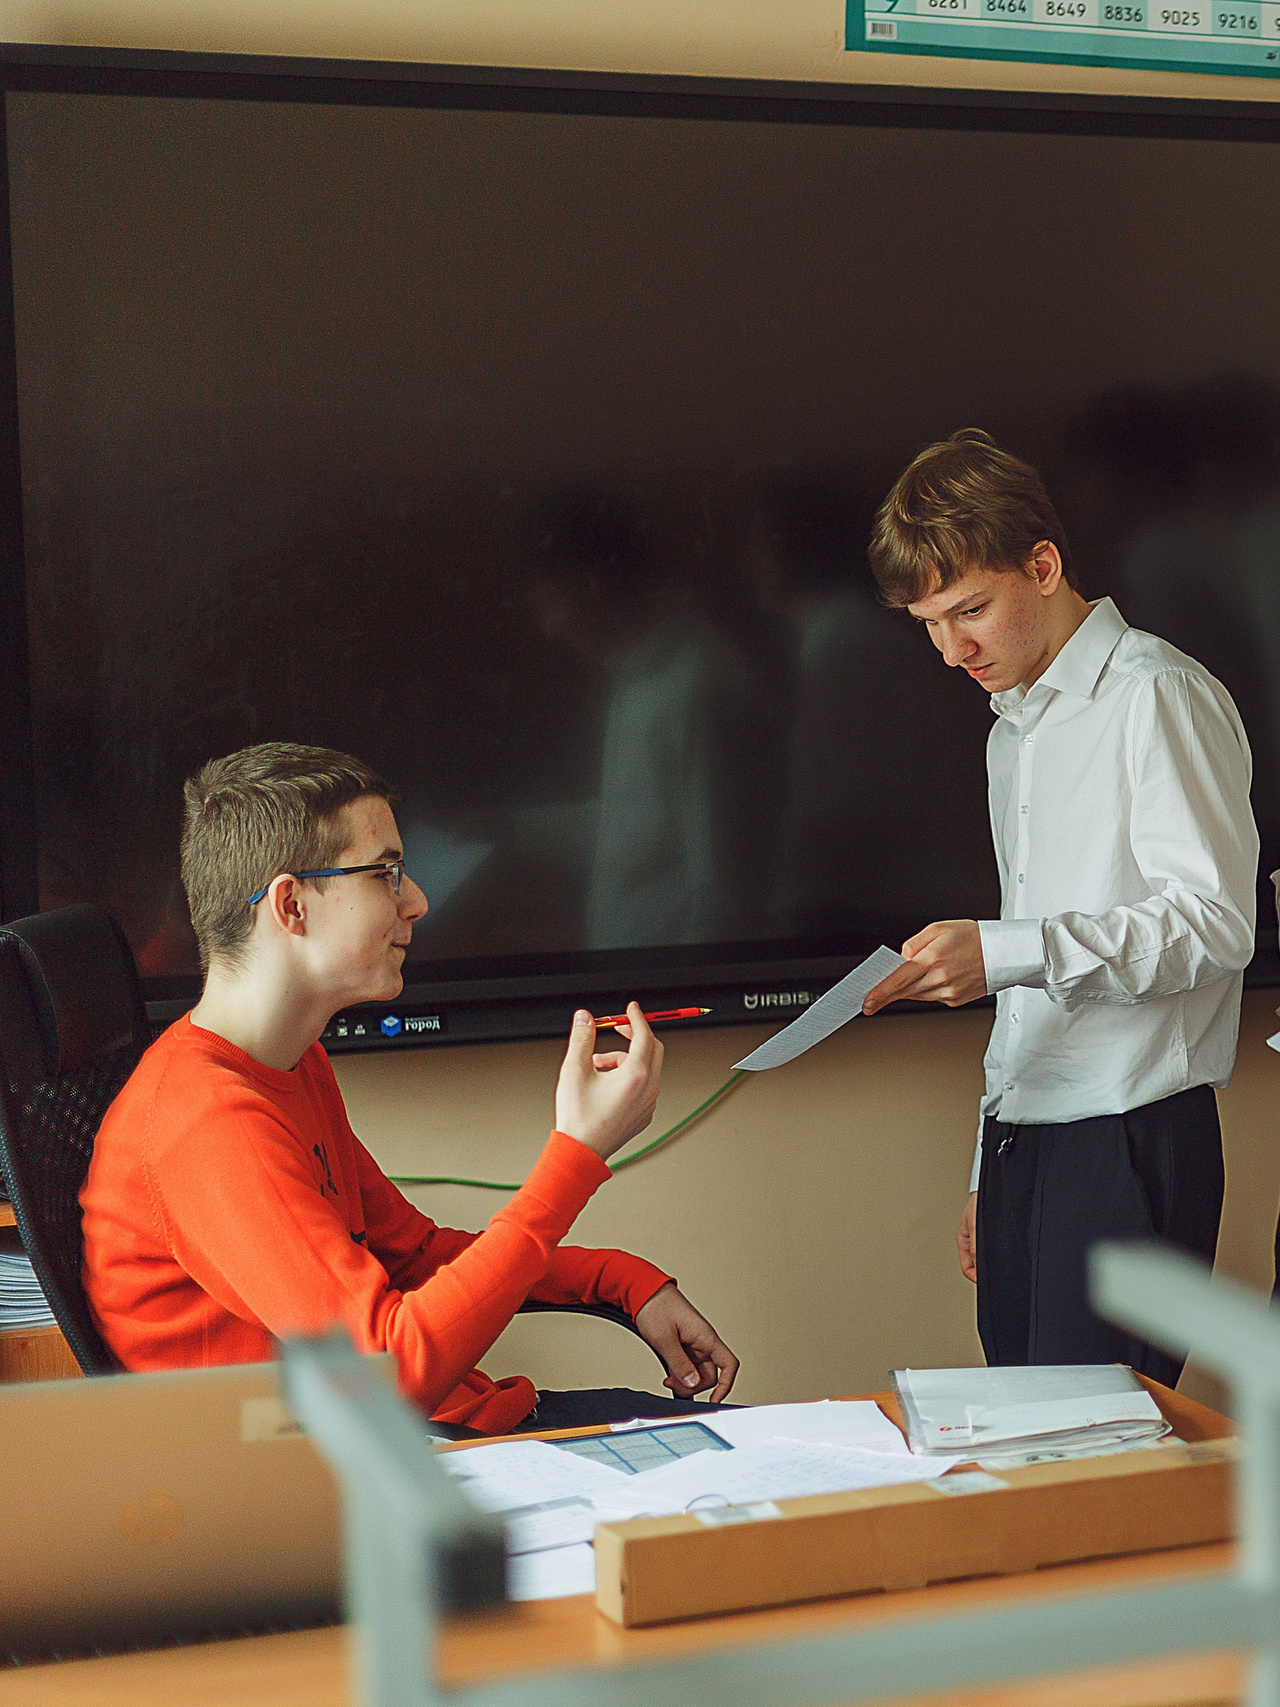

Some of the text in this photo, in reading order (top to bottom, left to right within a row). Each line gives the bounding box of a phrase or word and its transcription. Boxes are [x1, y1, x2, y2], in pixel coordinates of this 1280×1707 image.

[985, 0, 1027, 13] 8464
[1045, 2, 1087, 18] 8649
[1104, 5, 1143, 22] 8836
[1161, 10, 1200, 26] 9025
[1218, 13, 1257, 30] 9216
[761, 991, 810, 1007] IRBIS
